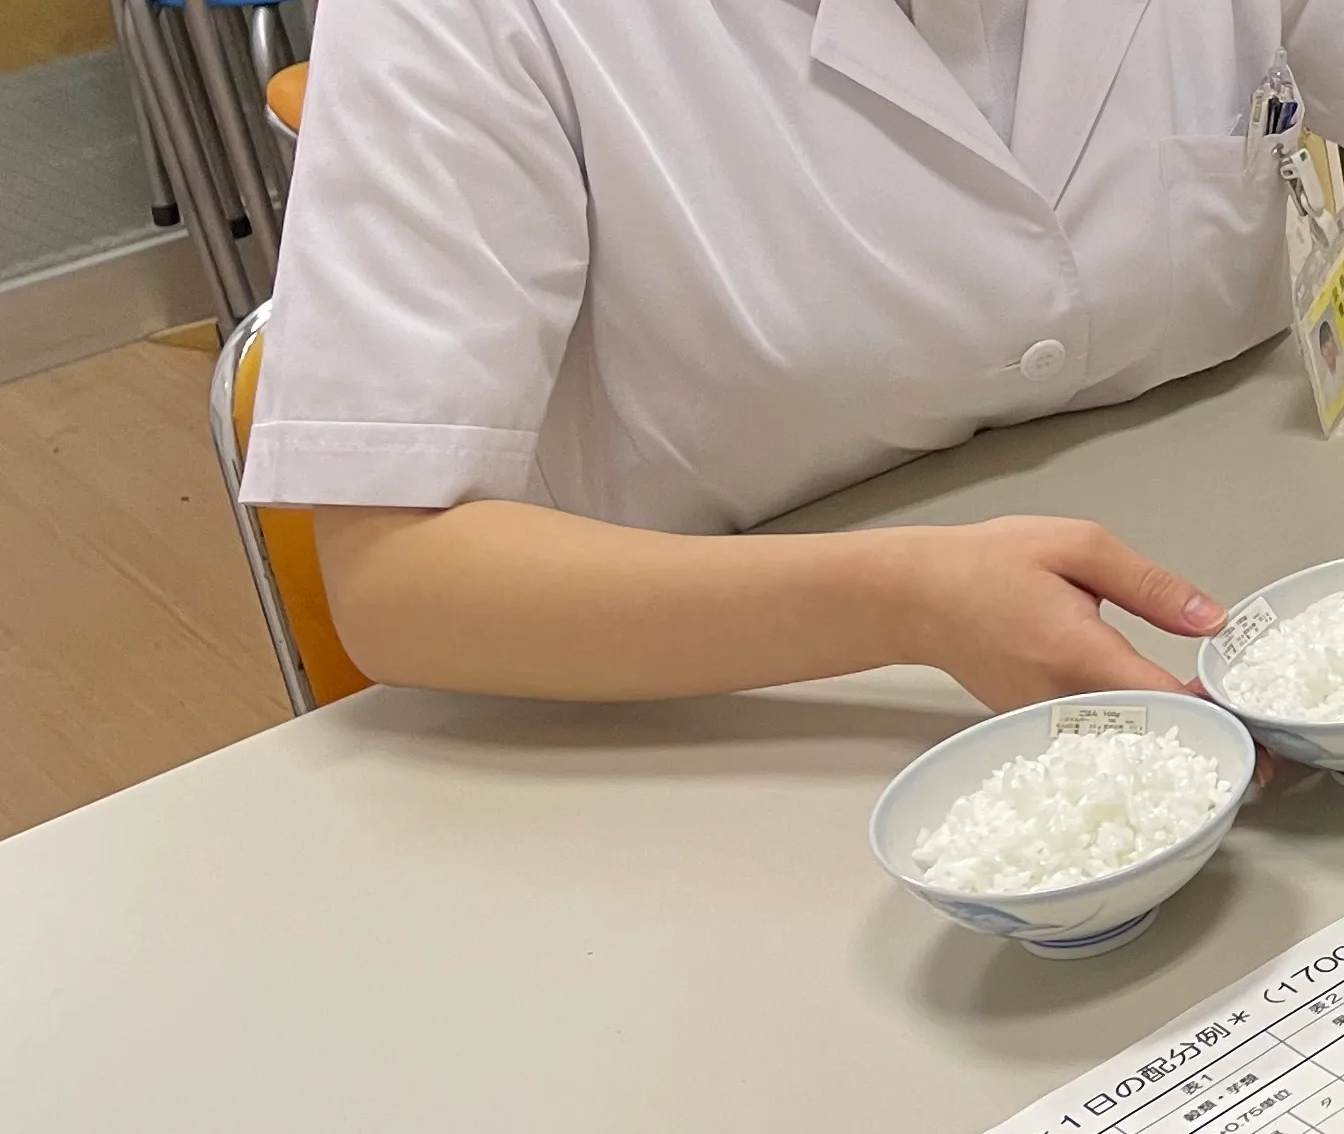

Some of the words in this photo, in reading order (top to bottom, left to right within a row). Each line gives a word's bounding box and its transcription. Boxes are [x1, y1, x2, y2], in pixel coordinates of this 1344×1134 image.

[1308, 992, 1344, 1016] 表2
[1181, 1072, 1215, 1097] 表1
[1183, 1072, 1260, 1122] 穀類・芋類
[1320, 1097, 1333, 1109] 夕
